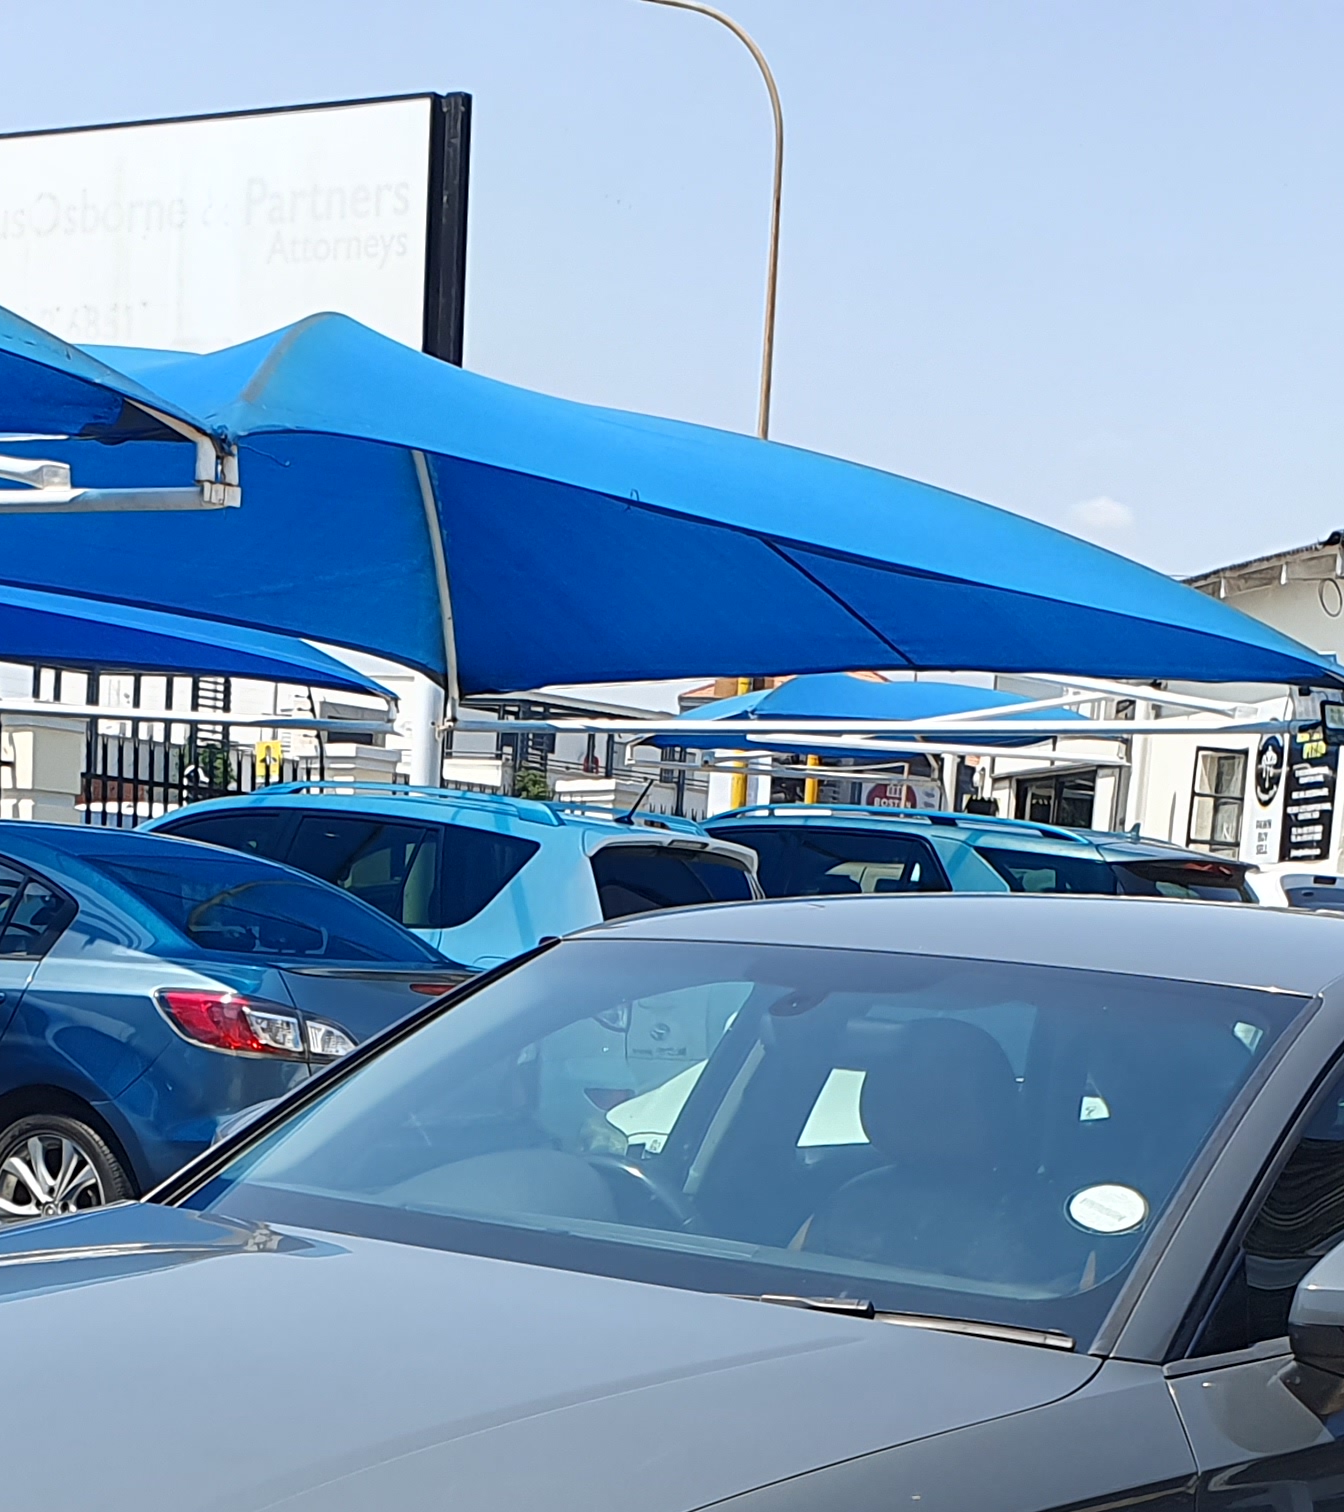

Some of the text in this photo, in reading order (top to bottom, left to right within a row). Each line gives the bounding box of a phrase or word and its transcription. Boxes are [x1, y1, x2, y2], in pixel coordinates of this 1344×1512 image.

[244, 176, 412, 229] Partners
[267, 230, 409, 270] Attorneys
[873, 797, 912, 808] BOSTN
